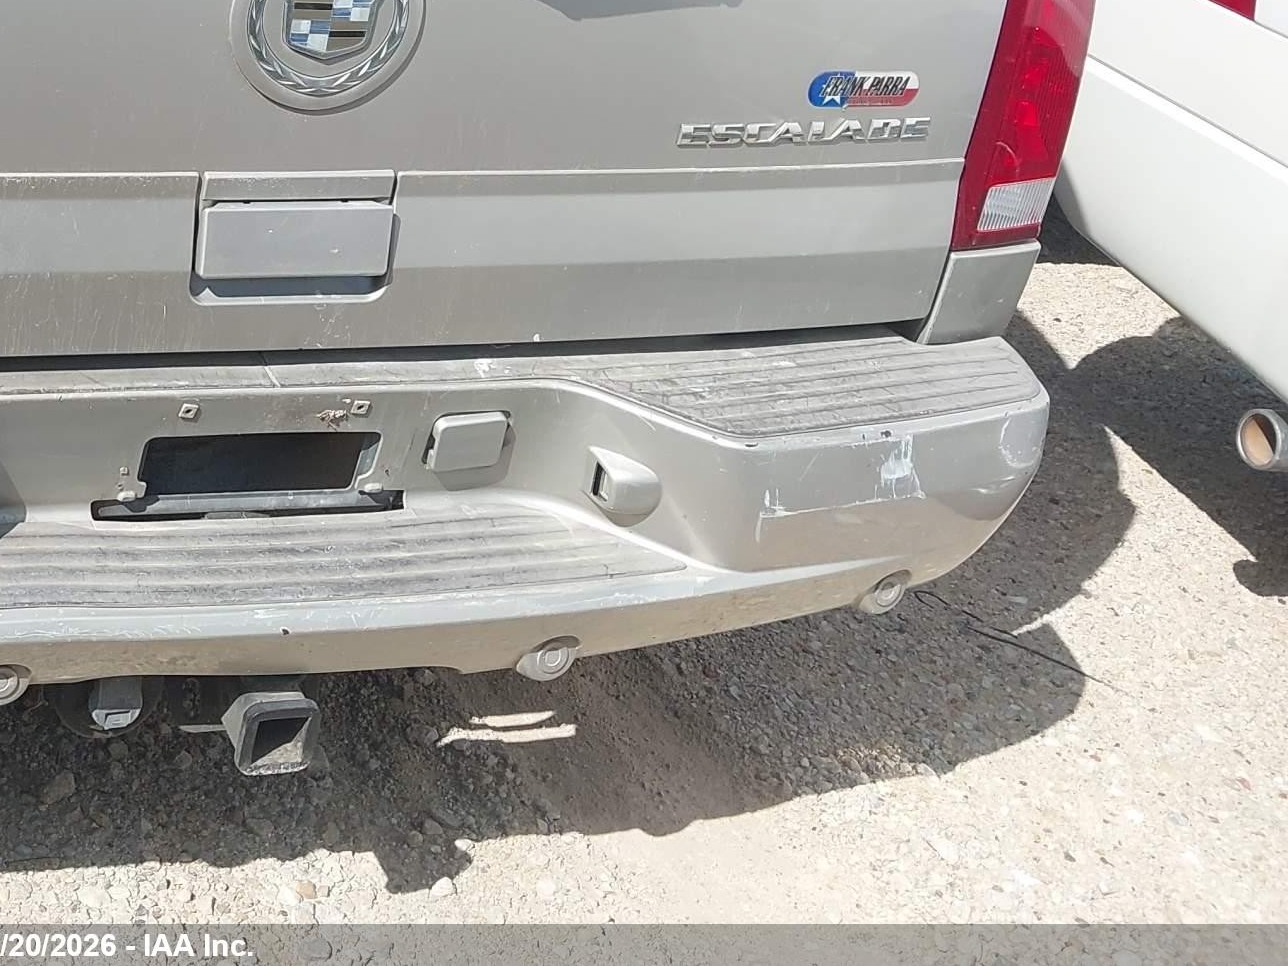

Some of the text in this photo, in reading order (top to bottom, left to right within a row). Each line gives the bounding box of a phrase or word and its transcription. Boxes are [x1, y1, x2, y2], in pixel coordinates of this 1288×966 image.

[818, 75, 911, 98] FRANK PARRA
[676, 117, 931, 147] ESCALADE
